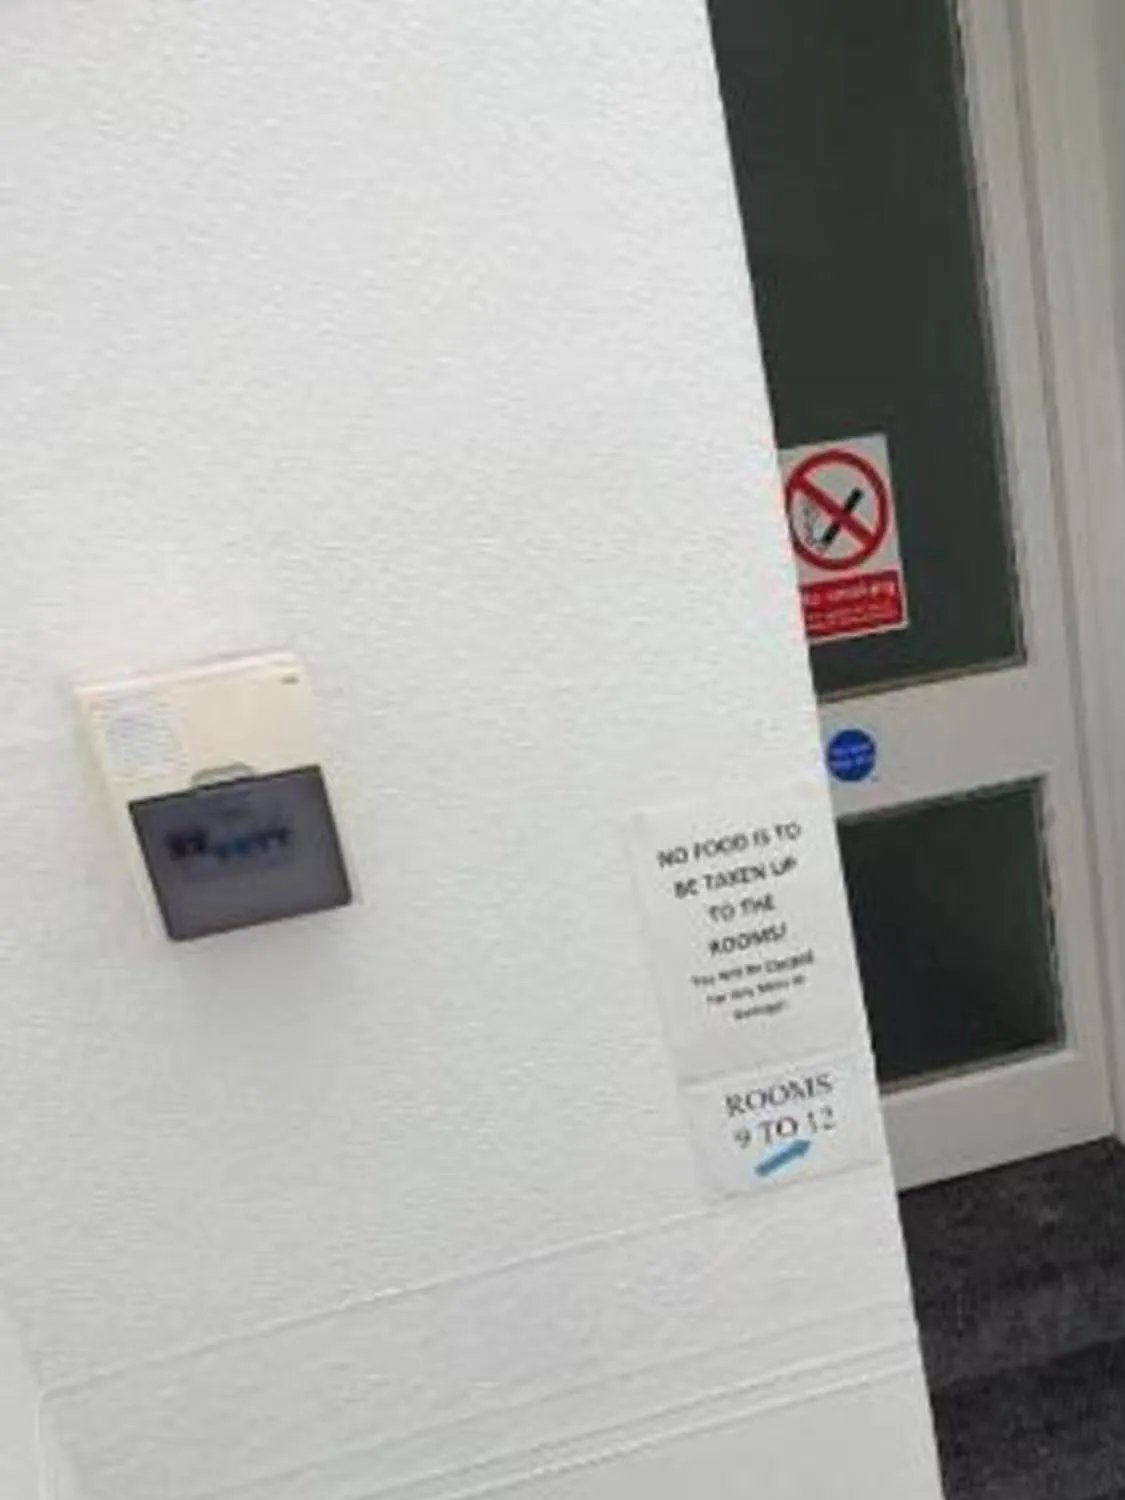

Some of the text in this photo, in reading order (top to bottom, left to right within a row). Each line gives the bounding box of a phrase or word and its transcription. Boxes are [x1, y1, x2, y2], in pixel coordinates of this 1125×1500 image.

[657, 821, 802, 869] NO FOOD IS TO
[674, 856, 797, 899] BE TAKEN UP
[709, 892, 776, 922] TO THE
[725, 1072, 832, 1117] ROOMS
[733, 1104, 836, 1149] 9 TO 12
